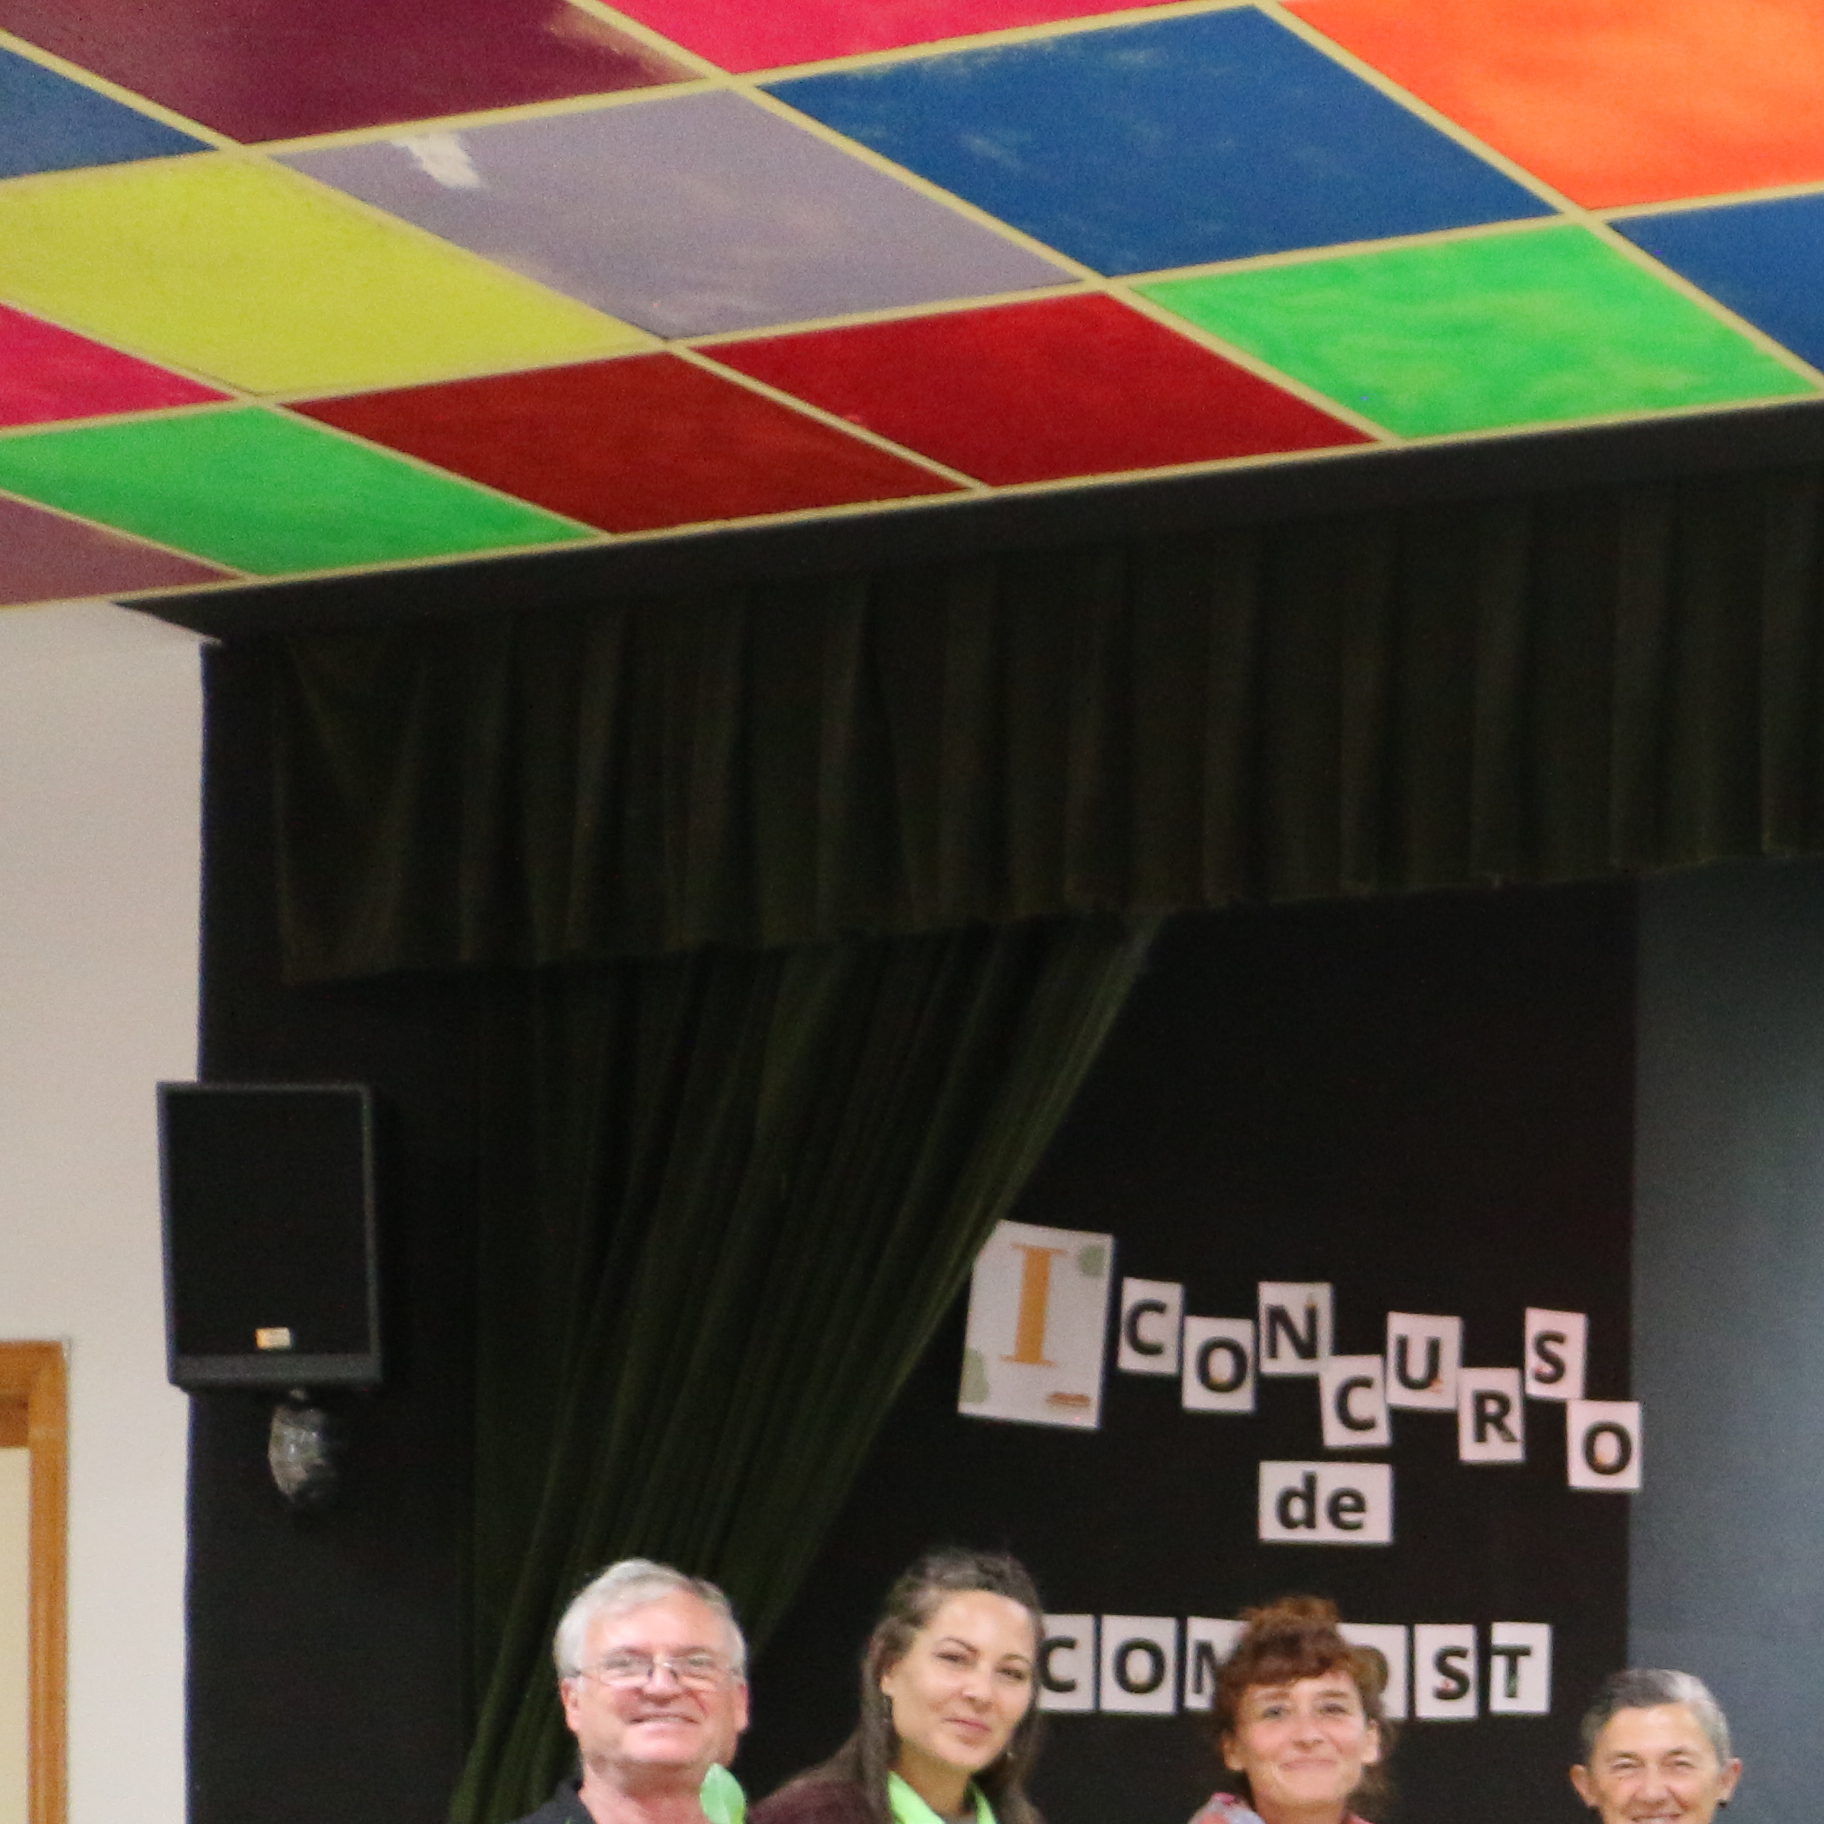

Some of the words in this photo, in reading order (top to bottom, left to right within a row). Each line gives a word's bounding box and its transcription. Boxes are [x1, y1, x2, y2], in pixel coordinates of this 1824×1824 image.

[1001, 1243, 1068, 1368] I
[1123, 1298, 1632, 1475] CONCURSO
[1276, 1471, 1367, 1531] de
[1038, 1636, 1532, 1701] COST
